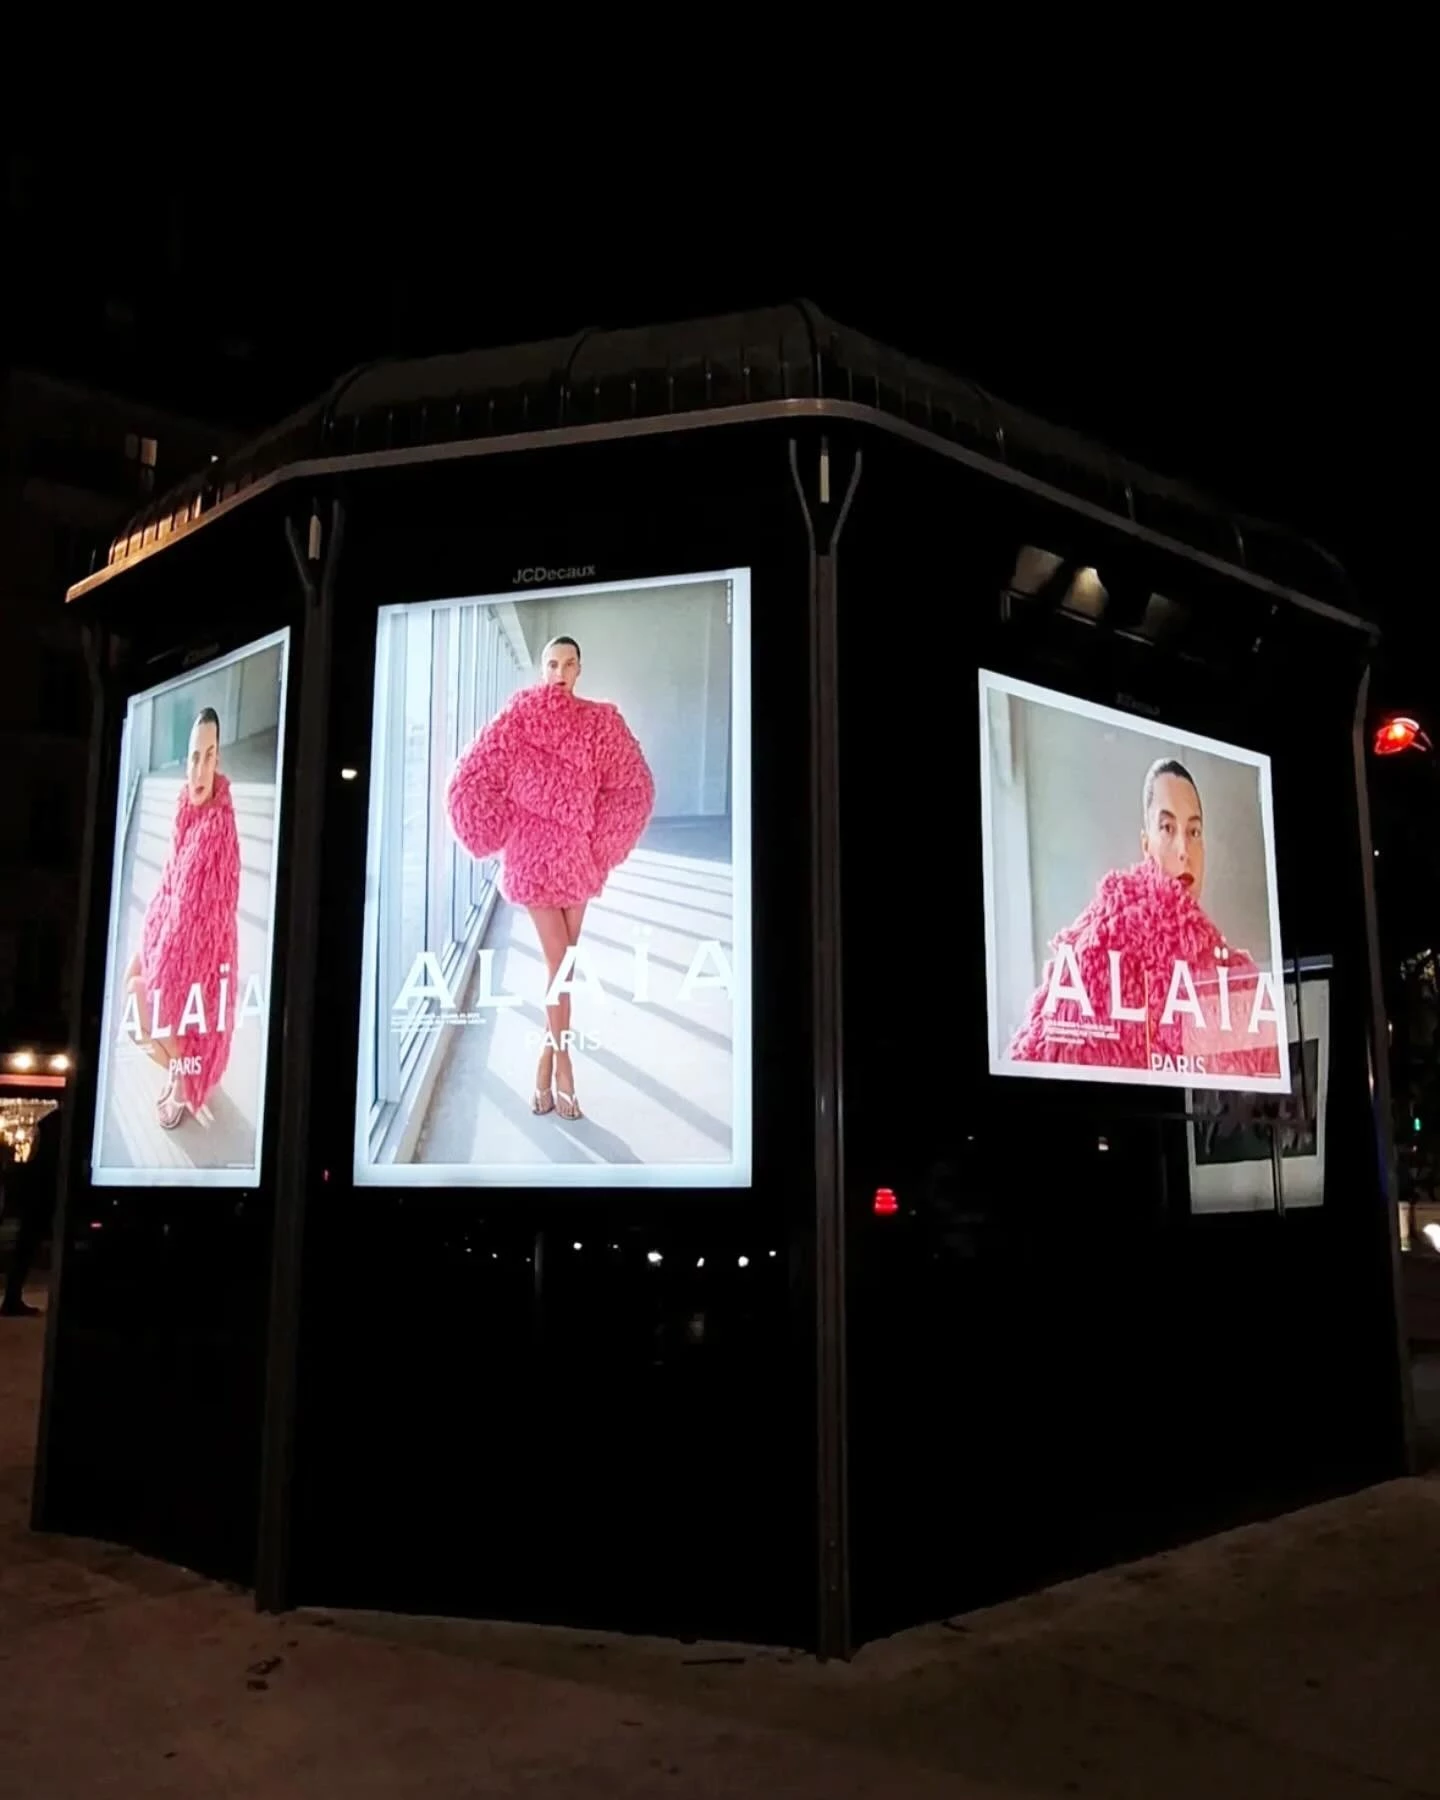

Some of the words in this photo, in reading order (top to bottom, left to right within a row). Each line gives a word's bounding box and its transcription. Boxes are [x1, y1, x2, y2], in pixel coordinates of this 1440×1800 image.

[512, 564, 597, 584] JCDecaux
[391, 925, 734, 1011] ALAÏA
[1041, 943, 1280, 1034] ALAÏA
[115, 963, 266, 1042] ALAÏA
[525, 1031, 600, 1052] PARIS
[168, 1056, 202, 1076] PARIS
[1151, 1053, 1207, 1075] PARIS
